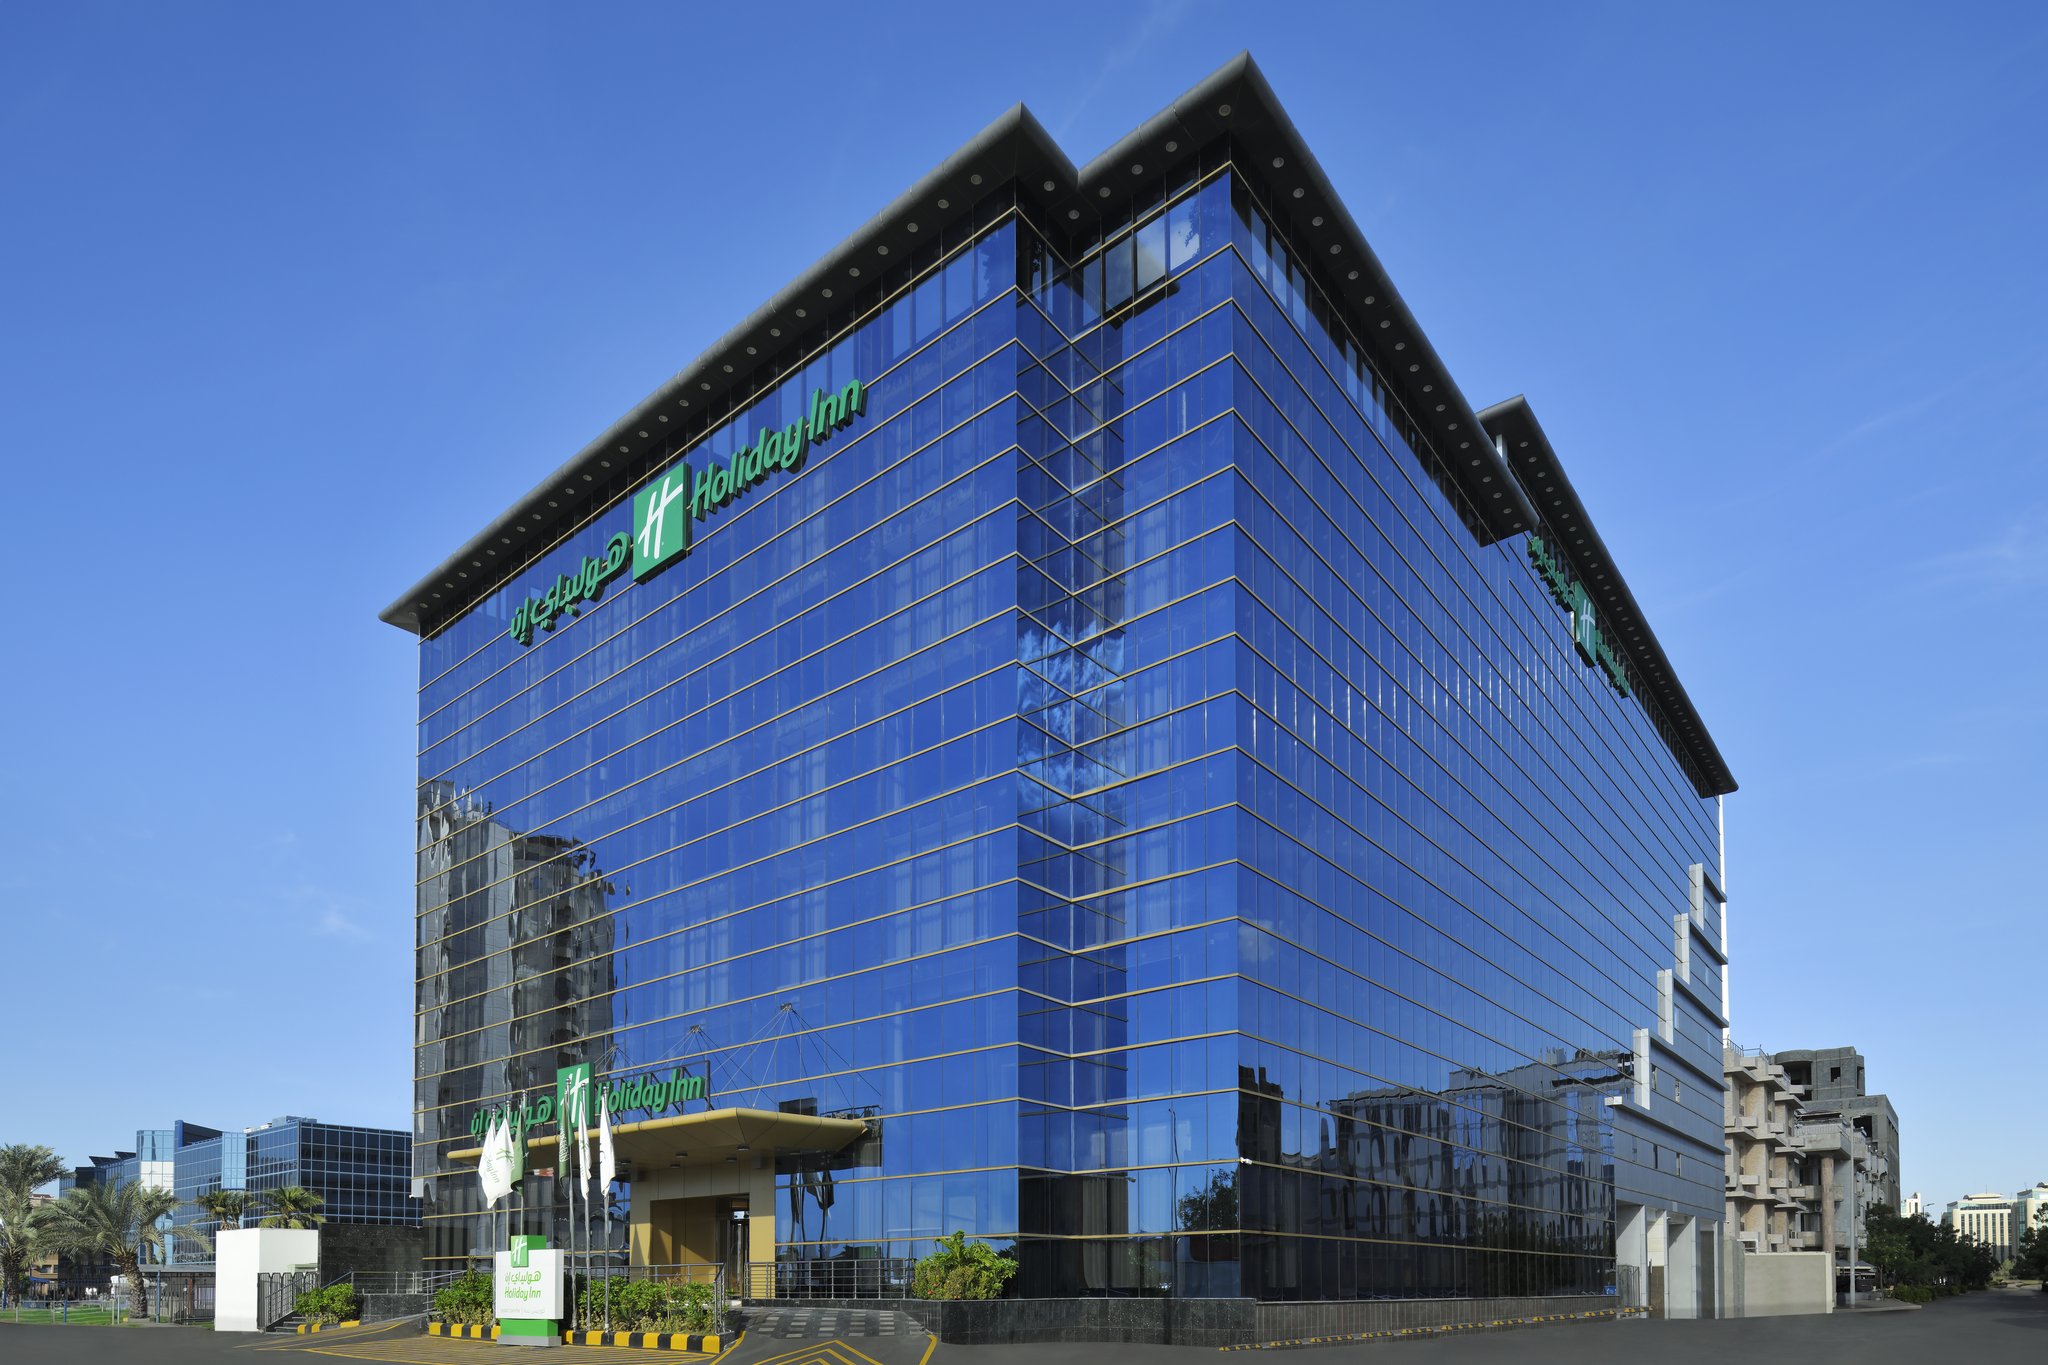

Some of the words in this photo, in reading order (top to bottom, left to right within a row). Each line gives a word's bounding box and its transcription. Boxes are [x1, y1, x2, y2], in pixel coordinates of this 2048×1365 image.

[692, 416, 806, 520] Holiday
[808, 379, 866, 444] Inn
[530, 531, 632, 632] هوليداي
[510, 597, 533, 647] إن
[595, 1075, 669, 1113] Holiday
[669, 1068, 705, 1104] Inn
[504, 1286, 529, 1301] Holiday
[529, 1286, 542, 1299] Inn
